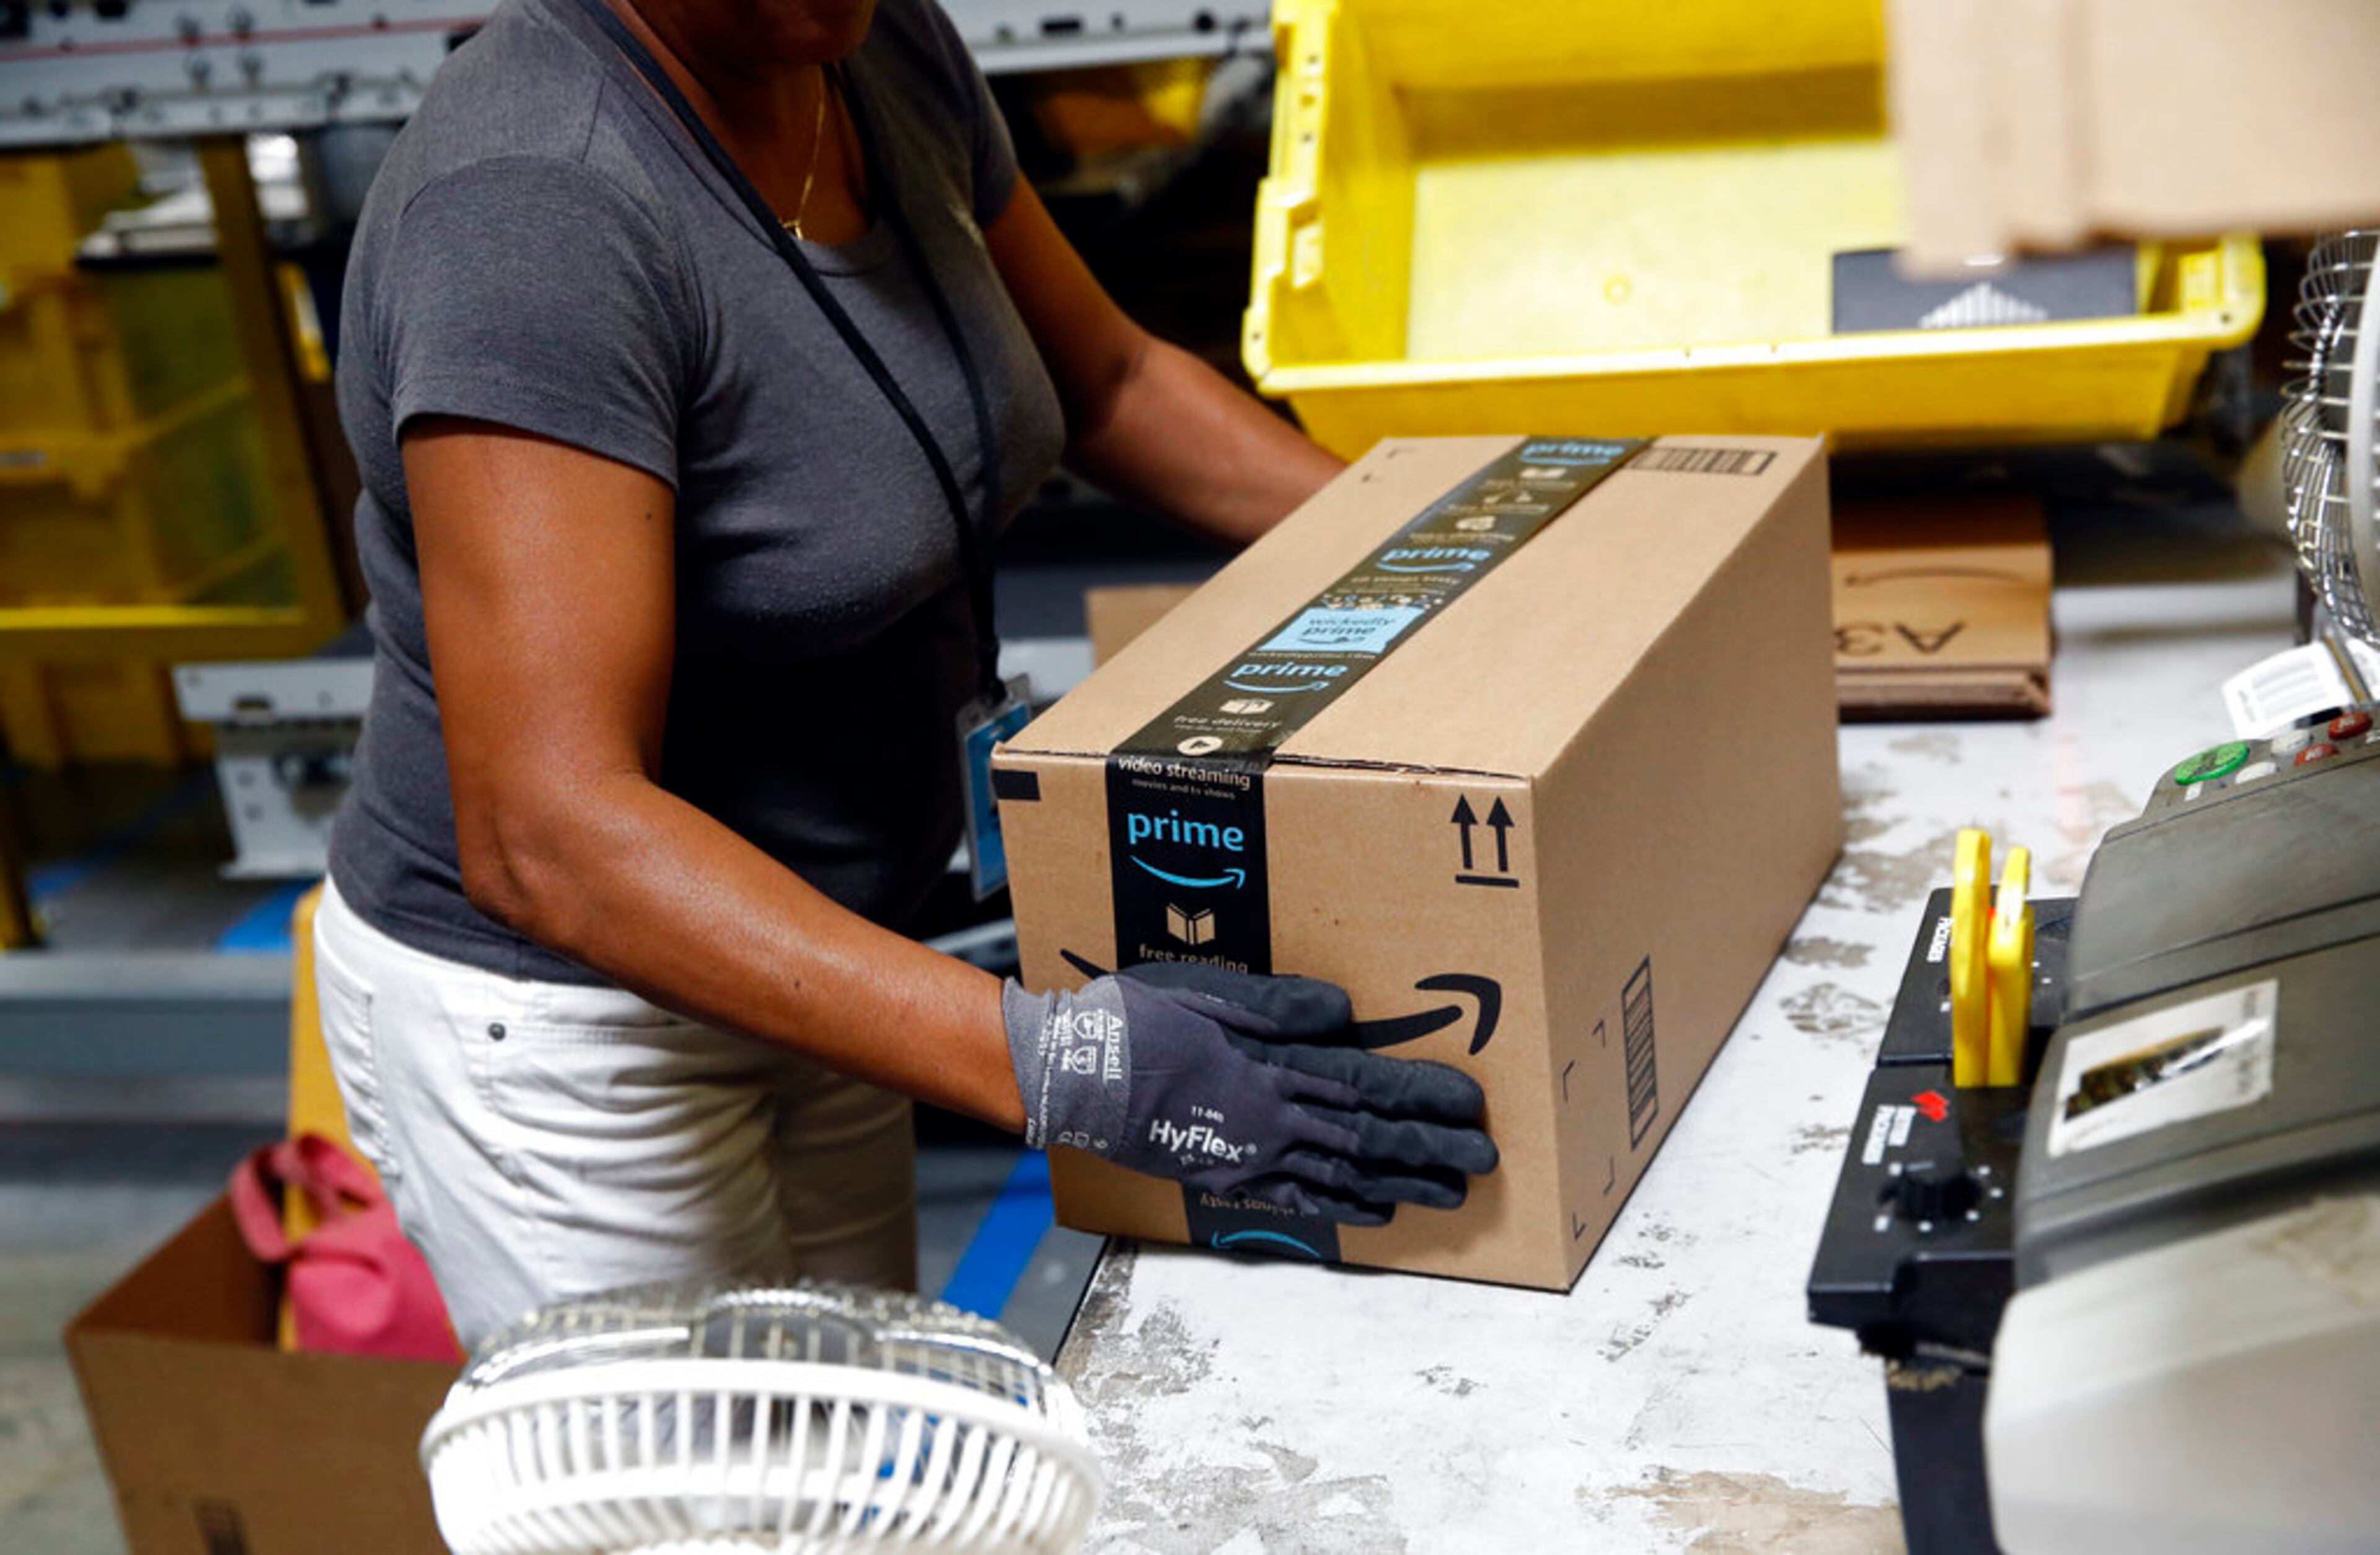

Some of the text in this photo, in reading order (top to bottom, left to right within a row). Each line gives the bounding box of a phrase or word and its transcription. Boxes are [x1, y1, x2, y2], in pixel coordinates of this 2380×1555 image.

[1522, 443, 1626, 457] prime
[1380, 546, 1492, 561] prime
[1302, 626, 1377, 637] prime
[1231, 661, 1351, 679] prime
[1118, 755, 1251, 791] video streaming
[1127, 808, 1245, 852] prime
[1139, 943, 1176, 961] free
[1106, 1015, 1124, 1080] Ansell
